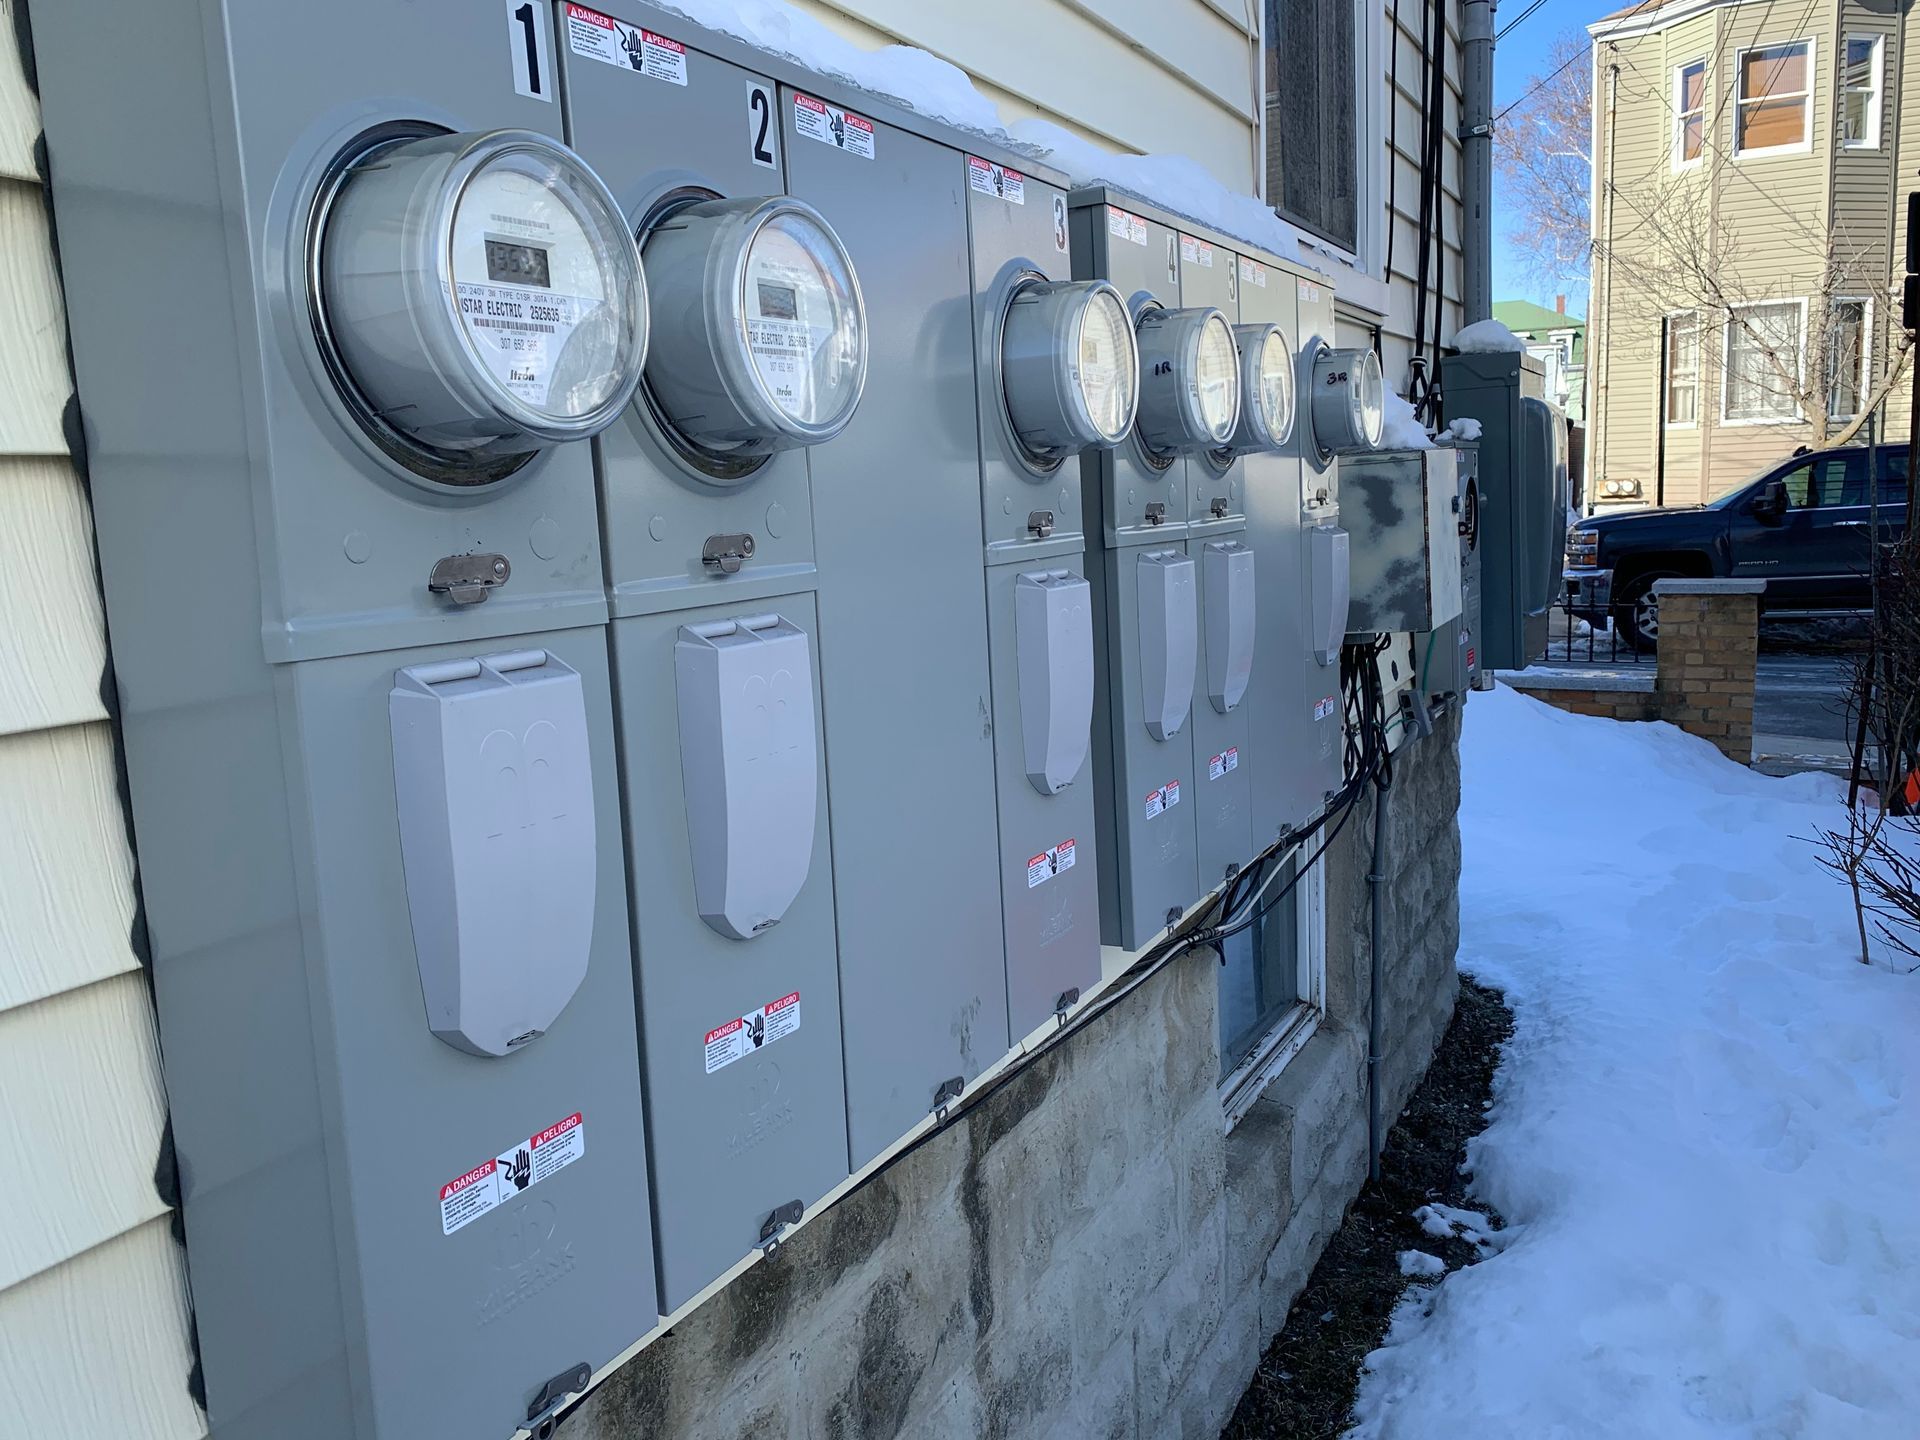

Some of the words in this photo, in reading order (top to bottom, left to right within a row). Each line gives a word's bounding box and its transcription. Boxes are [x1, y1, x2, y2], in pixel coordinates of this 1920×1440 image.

[577, 8, 610, 29] DANGER
[514, 3, 541, 95] 1
[652, 35, 681, 52] PELIGRO
[801, 97, 823, 112] DANGER
[751, 88, 773, 164] 2
[851, 117, 871, 132] PELIGRO
[1054, 198, 1065, 250] 3
[1168, 237, 1176, 282] 4
[1228, 260, 1236, 301] 5
[499, 291, 514, 300] TYPE
[487, 301, 523, 319] ELECTRIC
[529, 305, 560, 323] 2525635
[500, 337, 511, 349] 307
[513, 338, 525, 351] 652
[761, 332, 784, 346] ELECTRIC
[510, 366, 535, 381] Itron
[1154, 361, 1172, 376] 1R
[1327, 371, 1348, 385] 3R
[773, 994, 797, 1012] PELIGRO
[713, 1020, 739, 1039] DANGER
[543, 1116, 578, 1142] PELIGRO
[453, 1163, 492, 1192] DANGER
